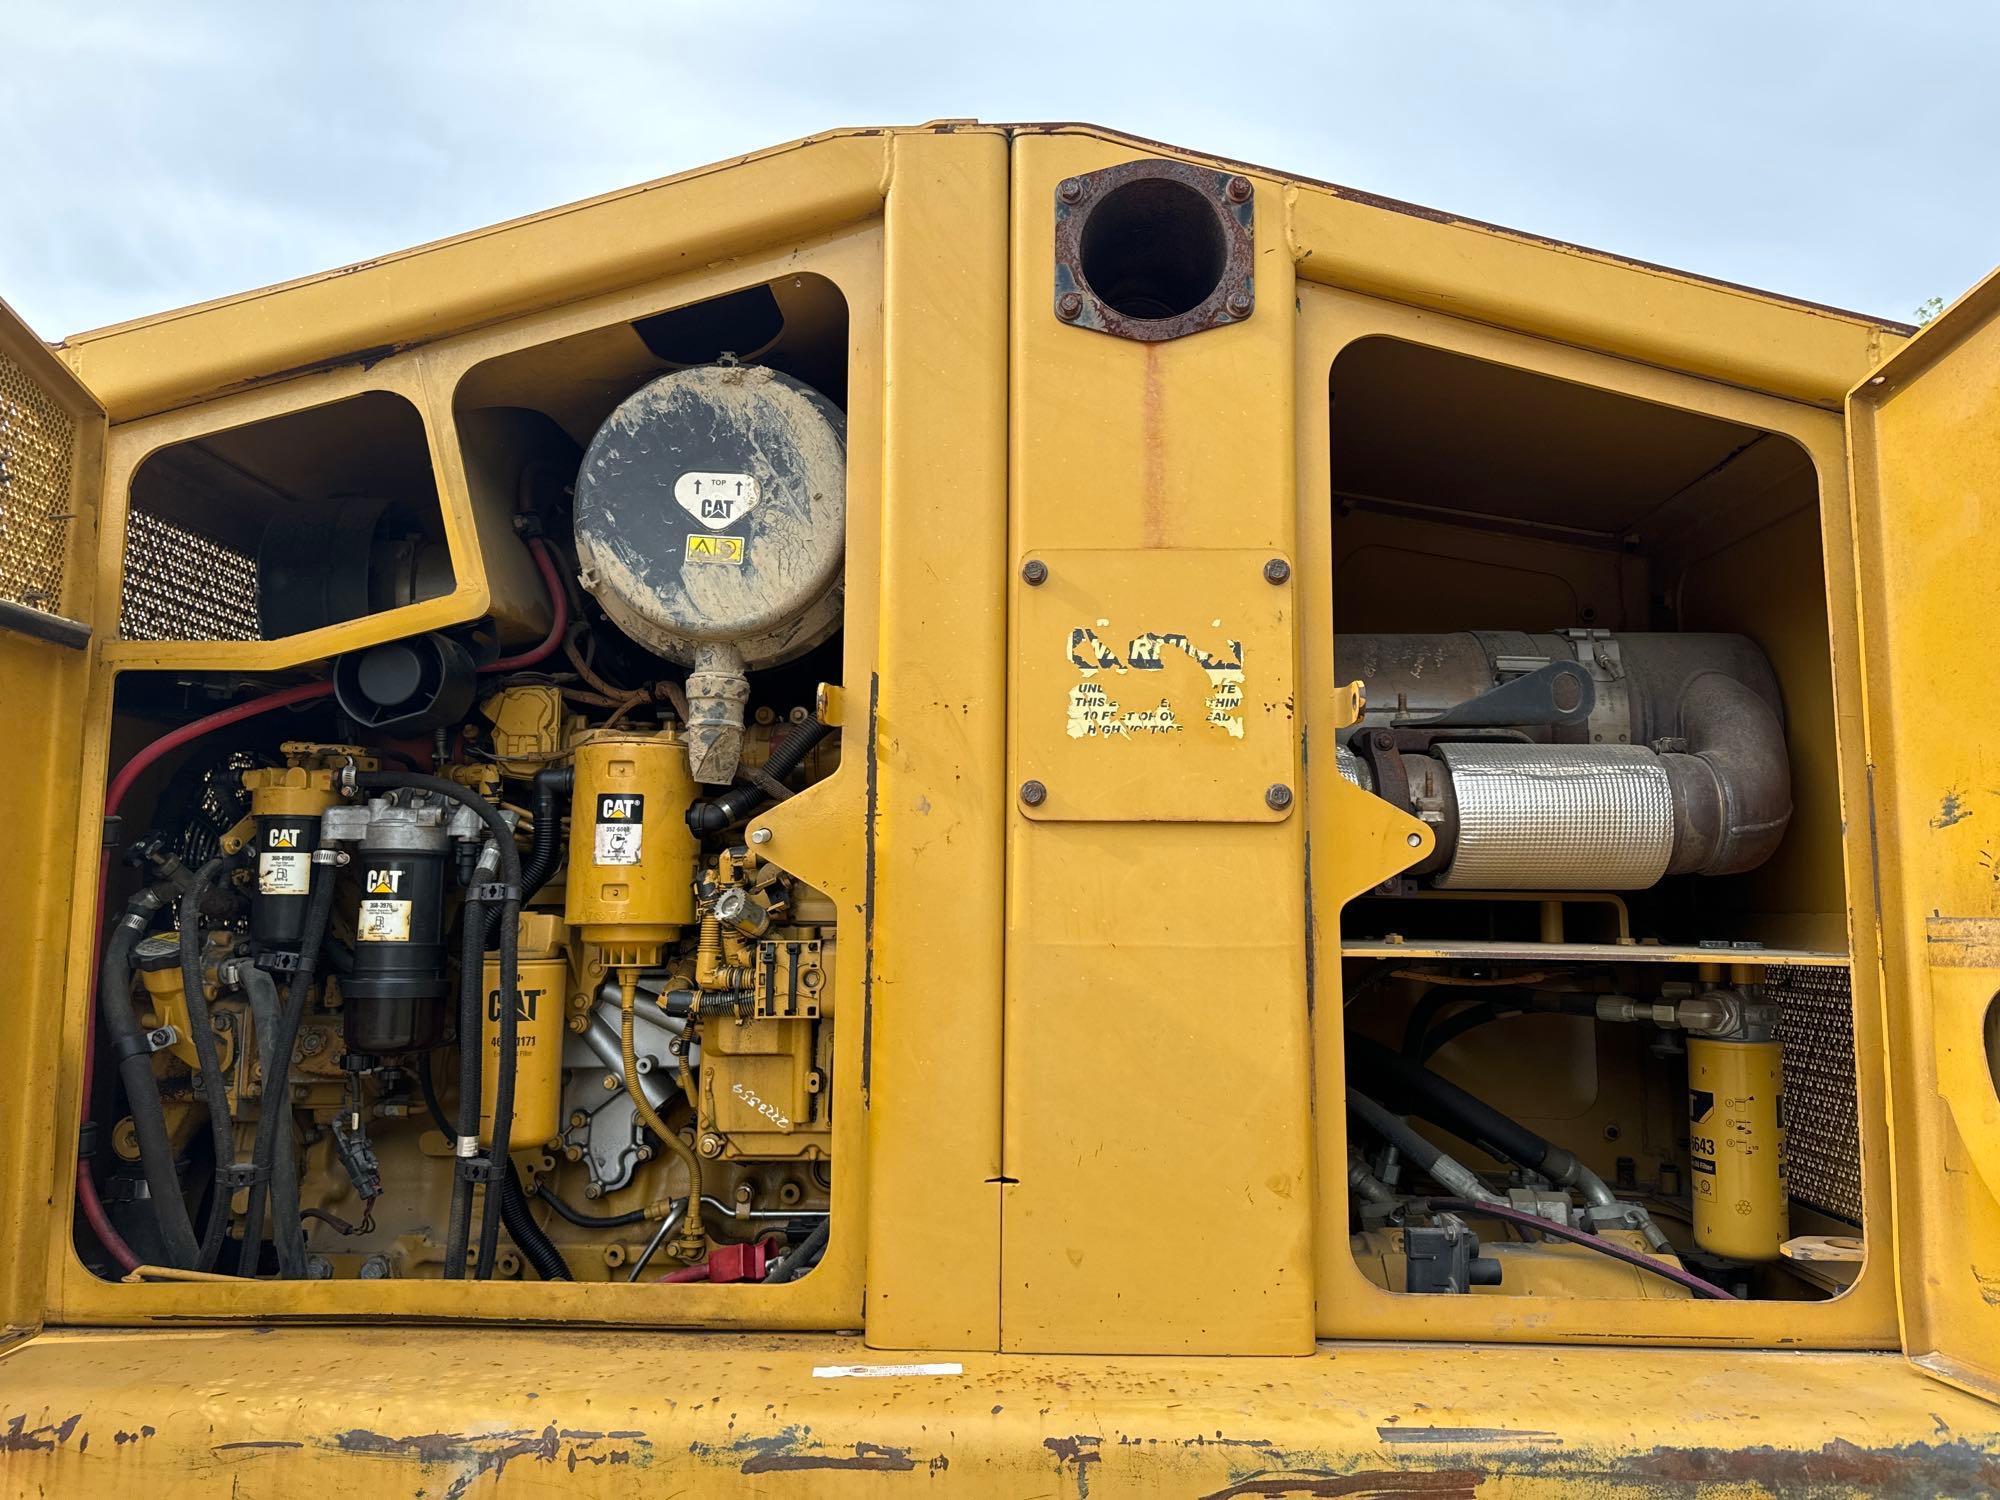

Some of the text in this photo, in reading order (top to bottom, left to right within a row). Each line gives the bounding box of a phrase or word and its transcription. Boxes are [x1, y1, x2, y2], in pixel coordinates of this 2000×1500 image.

[701, 499, 735, 519] CAT
[1075, 697, 1106, 707] THIS
[1083, 711, 1098, 721] 10
[1087, 724, 1121, 734] HGH
[603, 799, 635, 819] CAT
[269, 828, 300, 848] CAT
[366, 870, 403, 894] CAT
